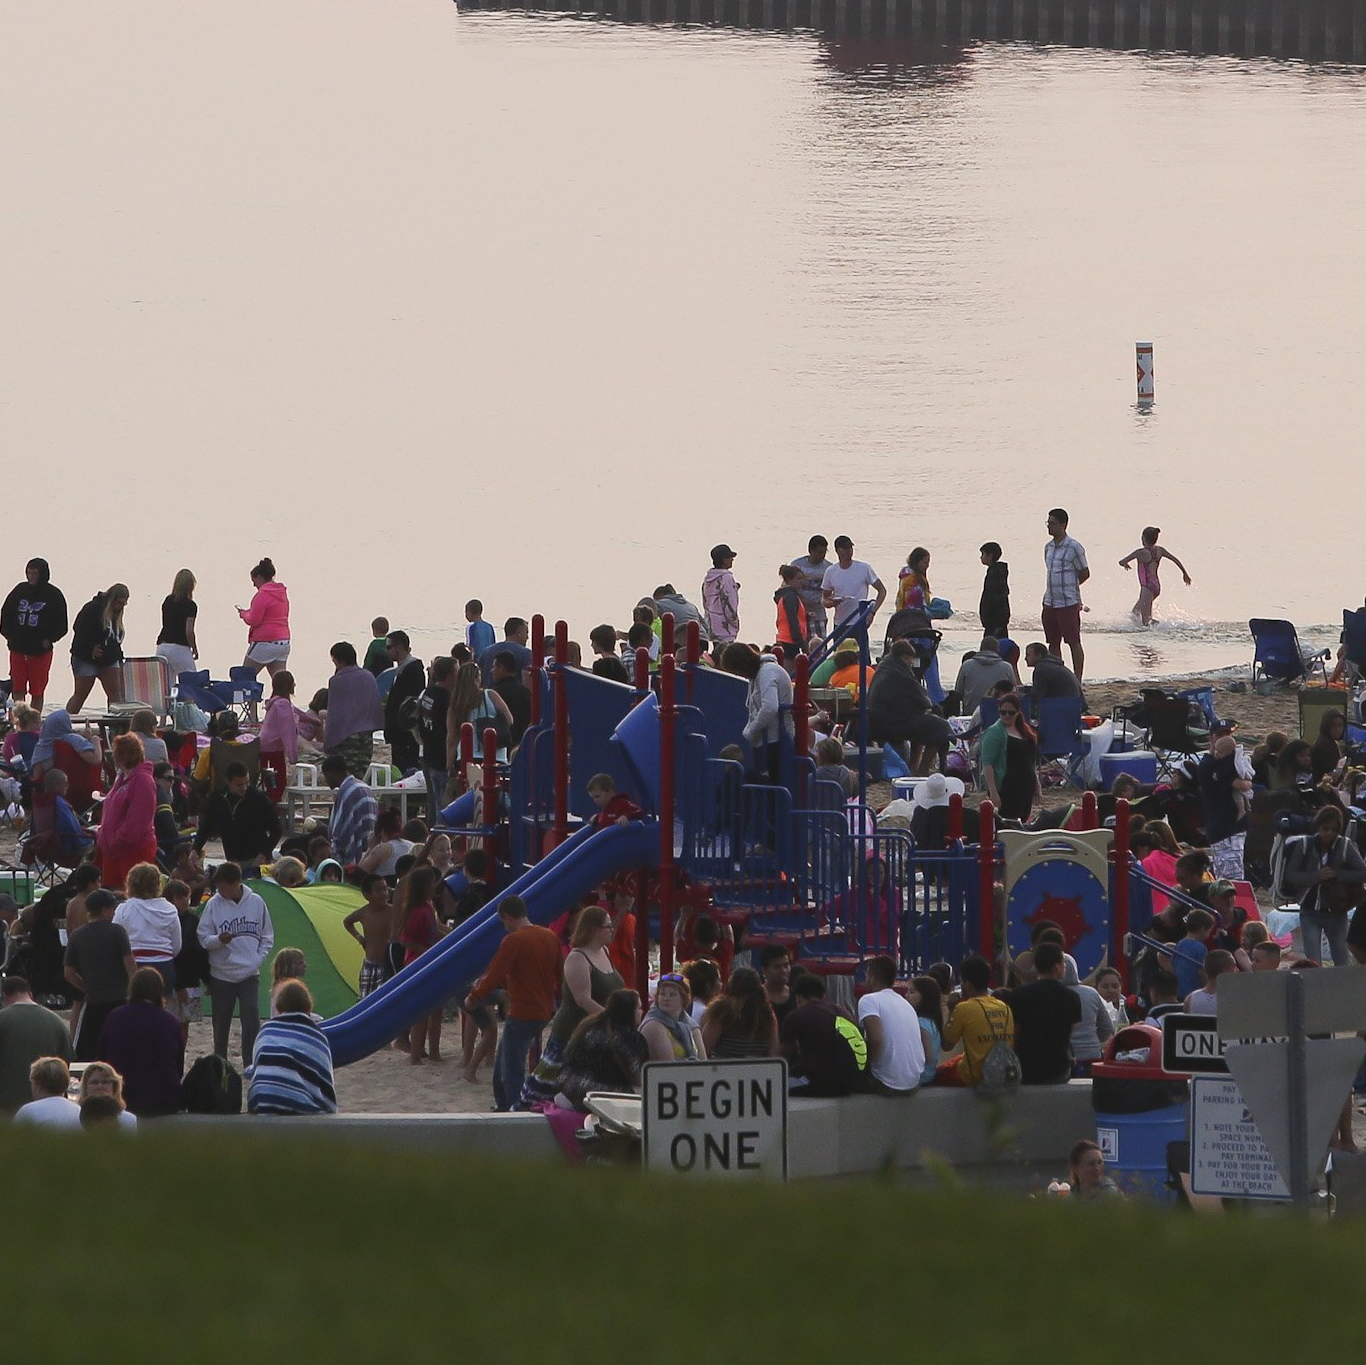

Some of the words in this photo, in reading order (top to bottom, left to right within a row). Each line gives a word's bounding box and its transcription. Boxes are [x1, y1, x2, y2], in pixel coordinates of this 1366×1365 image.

[1181, 1032, 1228, 1055] ONE
[657, 1079, 773, 1120] BEGIN
[1202, 1095, 1235, 1105] PARKING
[1213, 1124, 1233, 1132] NOTE
[1236, 1124, 1255, 1133] YOUR
[1219, 1133, 1242, 1142] SPACE
[671, 1131, 761, 1172] ONE
[1211, 1142, 1245, 1151] PROCEED
[1248, 1143, 1257, 1152] TO
[1221, 1152, 1235, 1161] PAY
[1237, 1153, 1273, 1162] TERMINAL
[1207, 1161, 1220, 1169] PAY
[1223, 1161, 1238, 1169] FOR
[1240, 1162, 1261, 1171] YOUR
[1215, 1170, 1238, 1179] ENJOY
[1241, 1171, 1261, 1180] YOUR
[1264, 1172, 1278, 1181] DAY
[1221, 1180, 1230, 1188] AT
[1233, 1180, 1246, 1189] THE
[1248, 1181, 1273, 1190] BEACH
